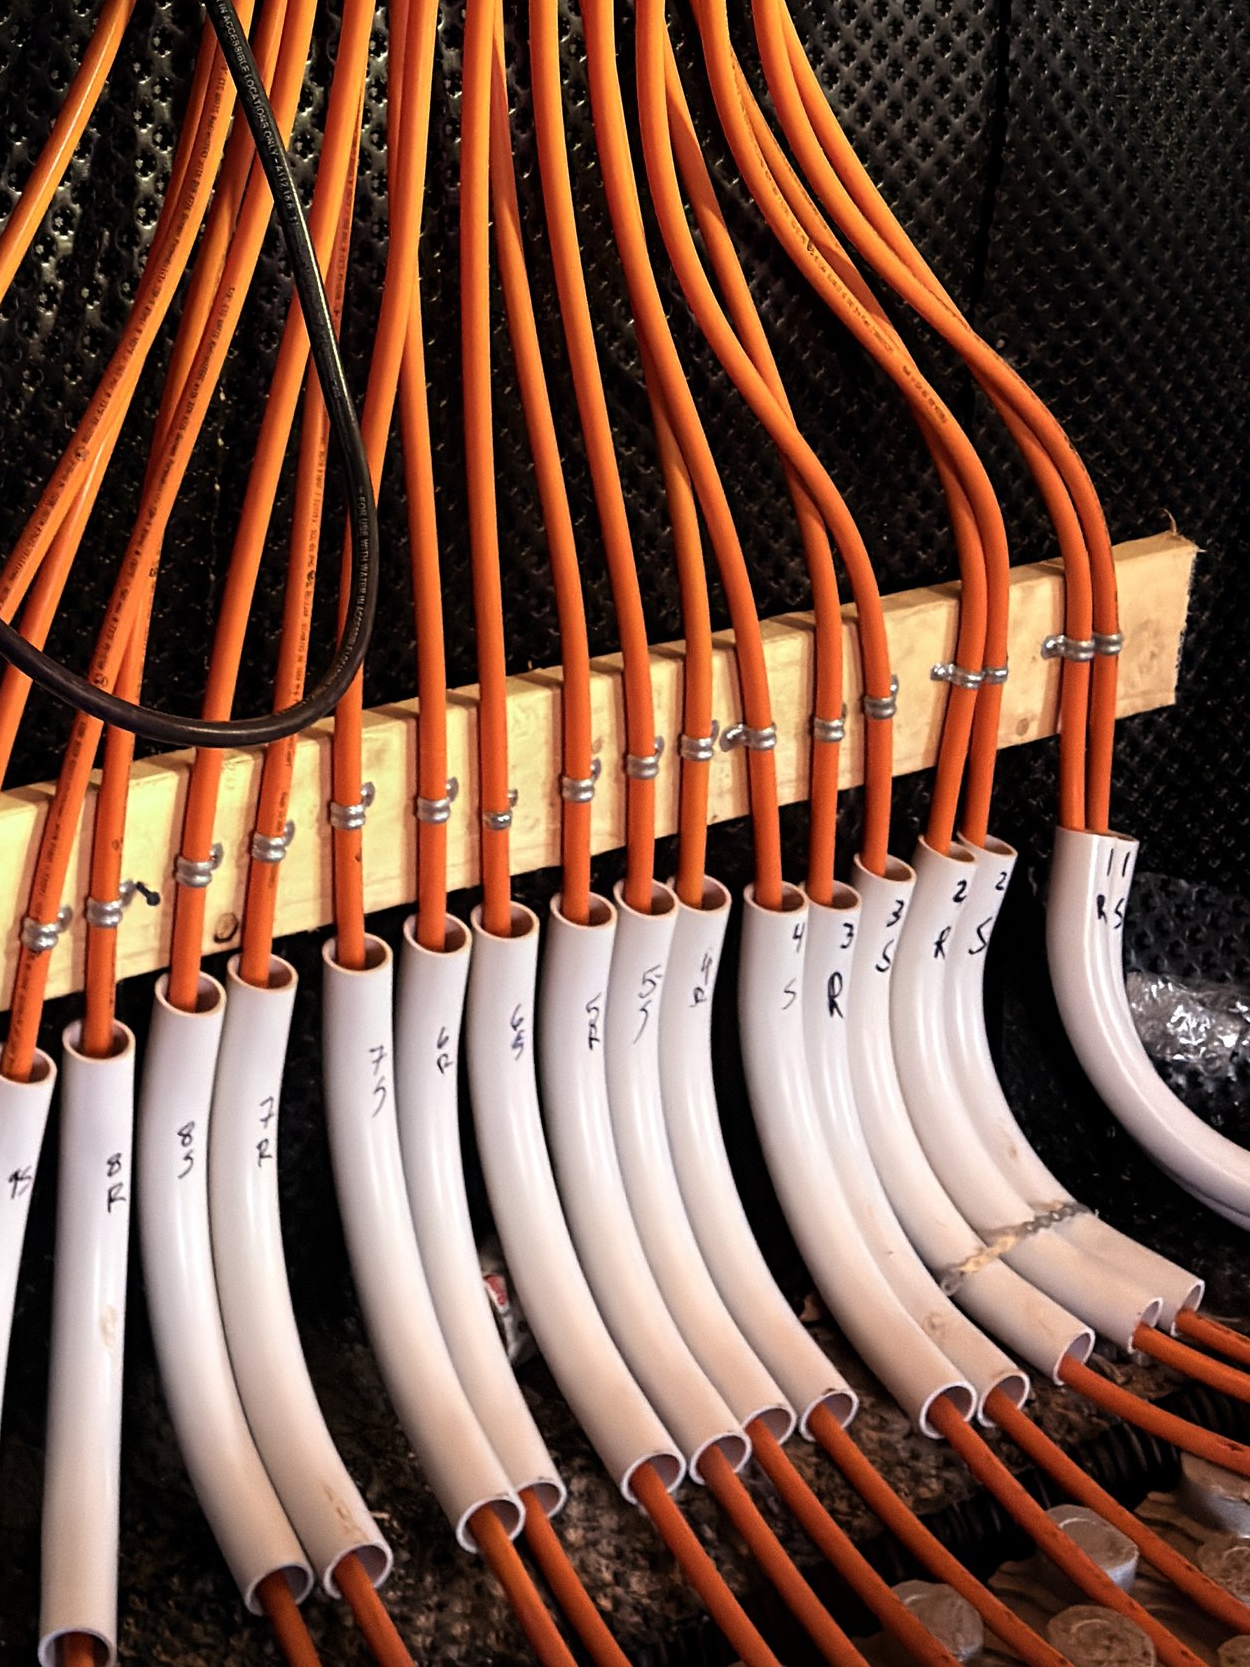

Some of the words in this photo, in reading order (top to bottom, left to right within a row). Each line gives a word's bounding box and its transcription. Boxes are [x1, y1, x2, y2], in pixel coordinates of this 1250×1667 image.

[218, 3, 228, 14] IN
[223, 15, 250, 73] ACCESSIBLE
[243, 73, 268, 130] LOCATIONS
[262, 130, 279, 157] ONLY
[358, 496, 366, 517] FOR
[361, 540, 369, 564] WITH
[952, 880, 967, 903] 2
[995, 872, 1008, 891] 2
[886, 900, 904, 926] 3
[1096, 894, 1108, 924] R
[792, 924, 805, 952] 4
[840, 923, 854, 949] 3
[968, 918, 992, 955] S
[876, 939, 895, 972] S
[827, 971, 844, 1018] R
[436, 1026, 449, 1050] 6
[368, 1046, 386, 1075] 7
[177, 1121, 196, 1147] 8
[106, 1153, 121, 1178] 8
[106, 1184, 126, 1213] R
